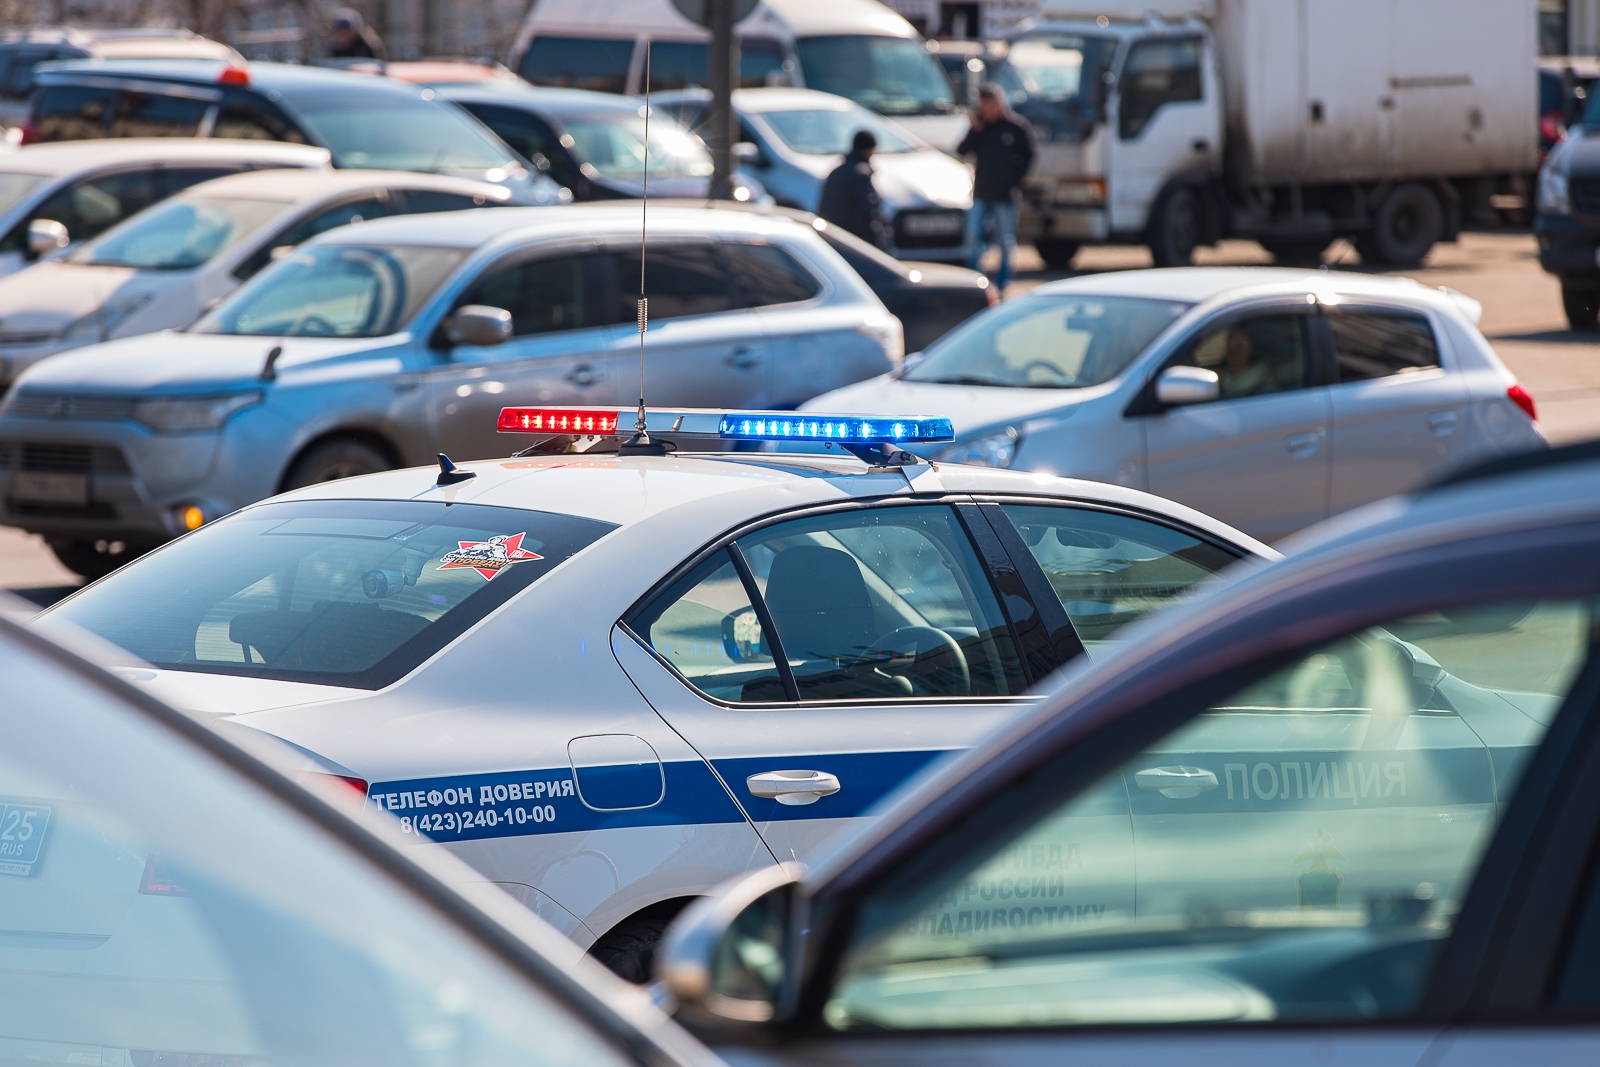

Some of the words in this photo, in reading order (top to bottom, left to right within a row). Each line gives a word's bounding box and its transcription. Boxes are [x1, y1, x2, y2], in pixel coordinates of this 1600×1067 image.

[372, 787, 473, 810] ТЕЛЕФОН
[479, 779, 575, 806] ДОВЕРИЯ
[1224, 761, 1407, 806] ПОЛИЦИЯ
[1, 809, 38, 842] 25
[400, 805, 556, 835] 8(423)240-10-00
[0, 843, 24, 856] RUS
[964, 874, 1065, 902] РОССИИ
